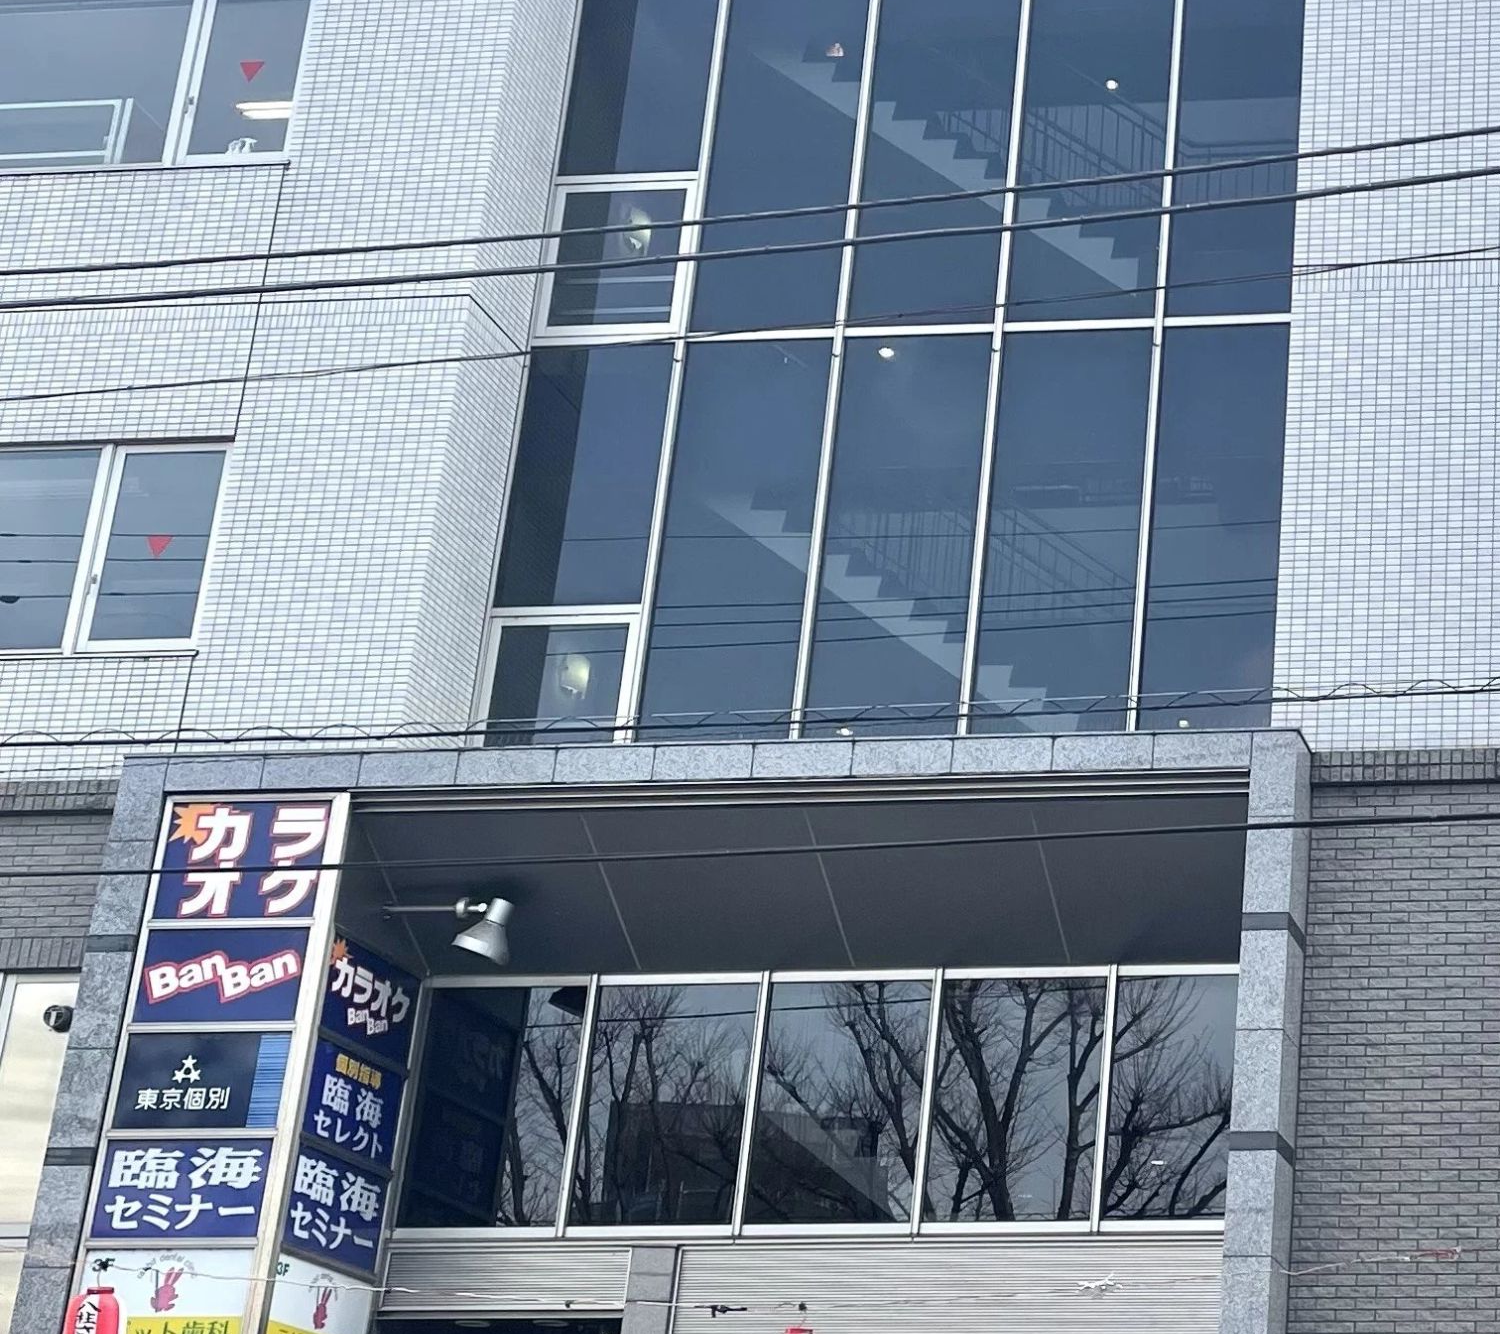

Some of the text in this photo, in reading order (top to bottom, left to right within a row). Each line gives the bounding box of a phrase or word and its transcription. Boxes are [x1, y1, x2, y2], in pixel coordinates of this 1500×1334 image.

[145, 950, 302, 1003] BanBan
[135, 1087, 230, 1111] 東京個別
[321, 1074, 385, 1129] 臨海
[313, 1109, 383, 1158] セレクト
[108, 1148, 262, 1190] 臨海
[294, 1155, 381, 1221] 臨海
[105, 1194, 255, 1232] セミナー
[290, 1201, 374, 1249] セミナー
